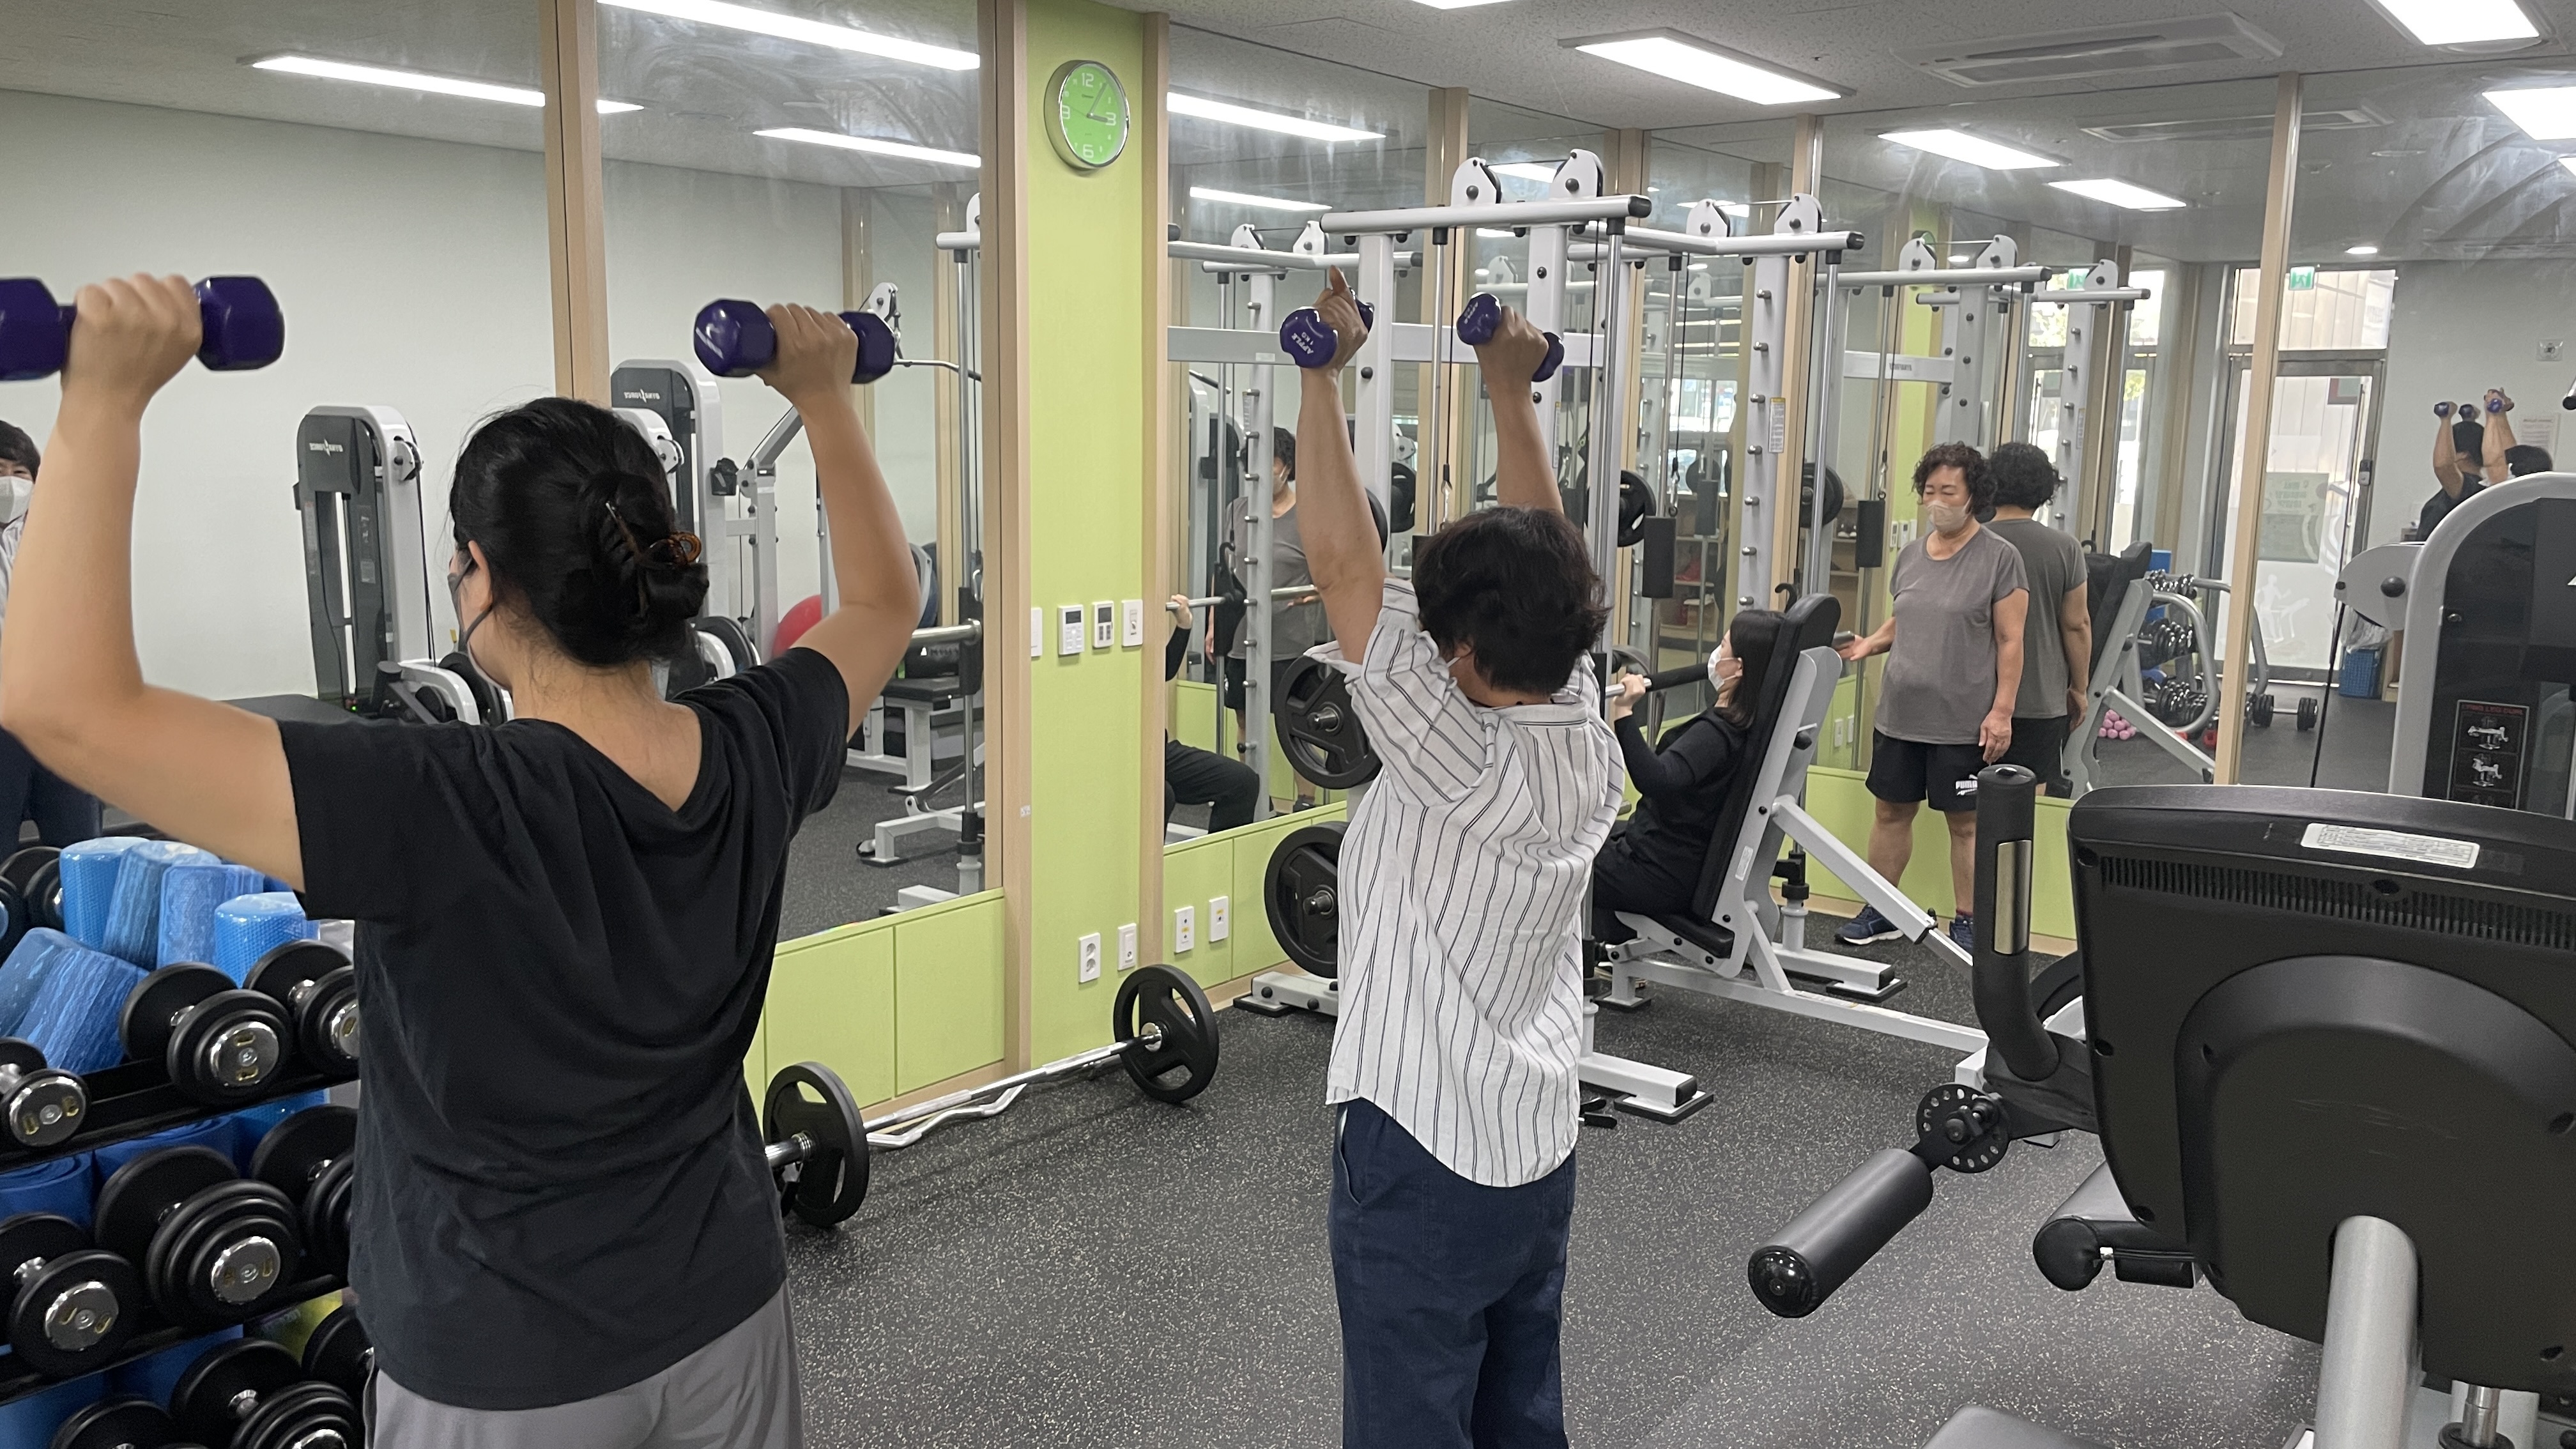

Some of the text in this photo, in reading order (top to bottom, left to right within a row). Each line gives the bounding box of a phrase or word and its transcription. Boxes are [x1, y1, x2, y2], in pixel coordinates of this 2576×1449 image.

[1082, 72, 1094, 88] 12
[1105, 112, 1116, 126] 3
[1083, 144, 1094, 158] 6
[1291, 333, 1314, 355] APPLE
[1956, 780, 1978, 790] PUMA
